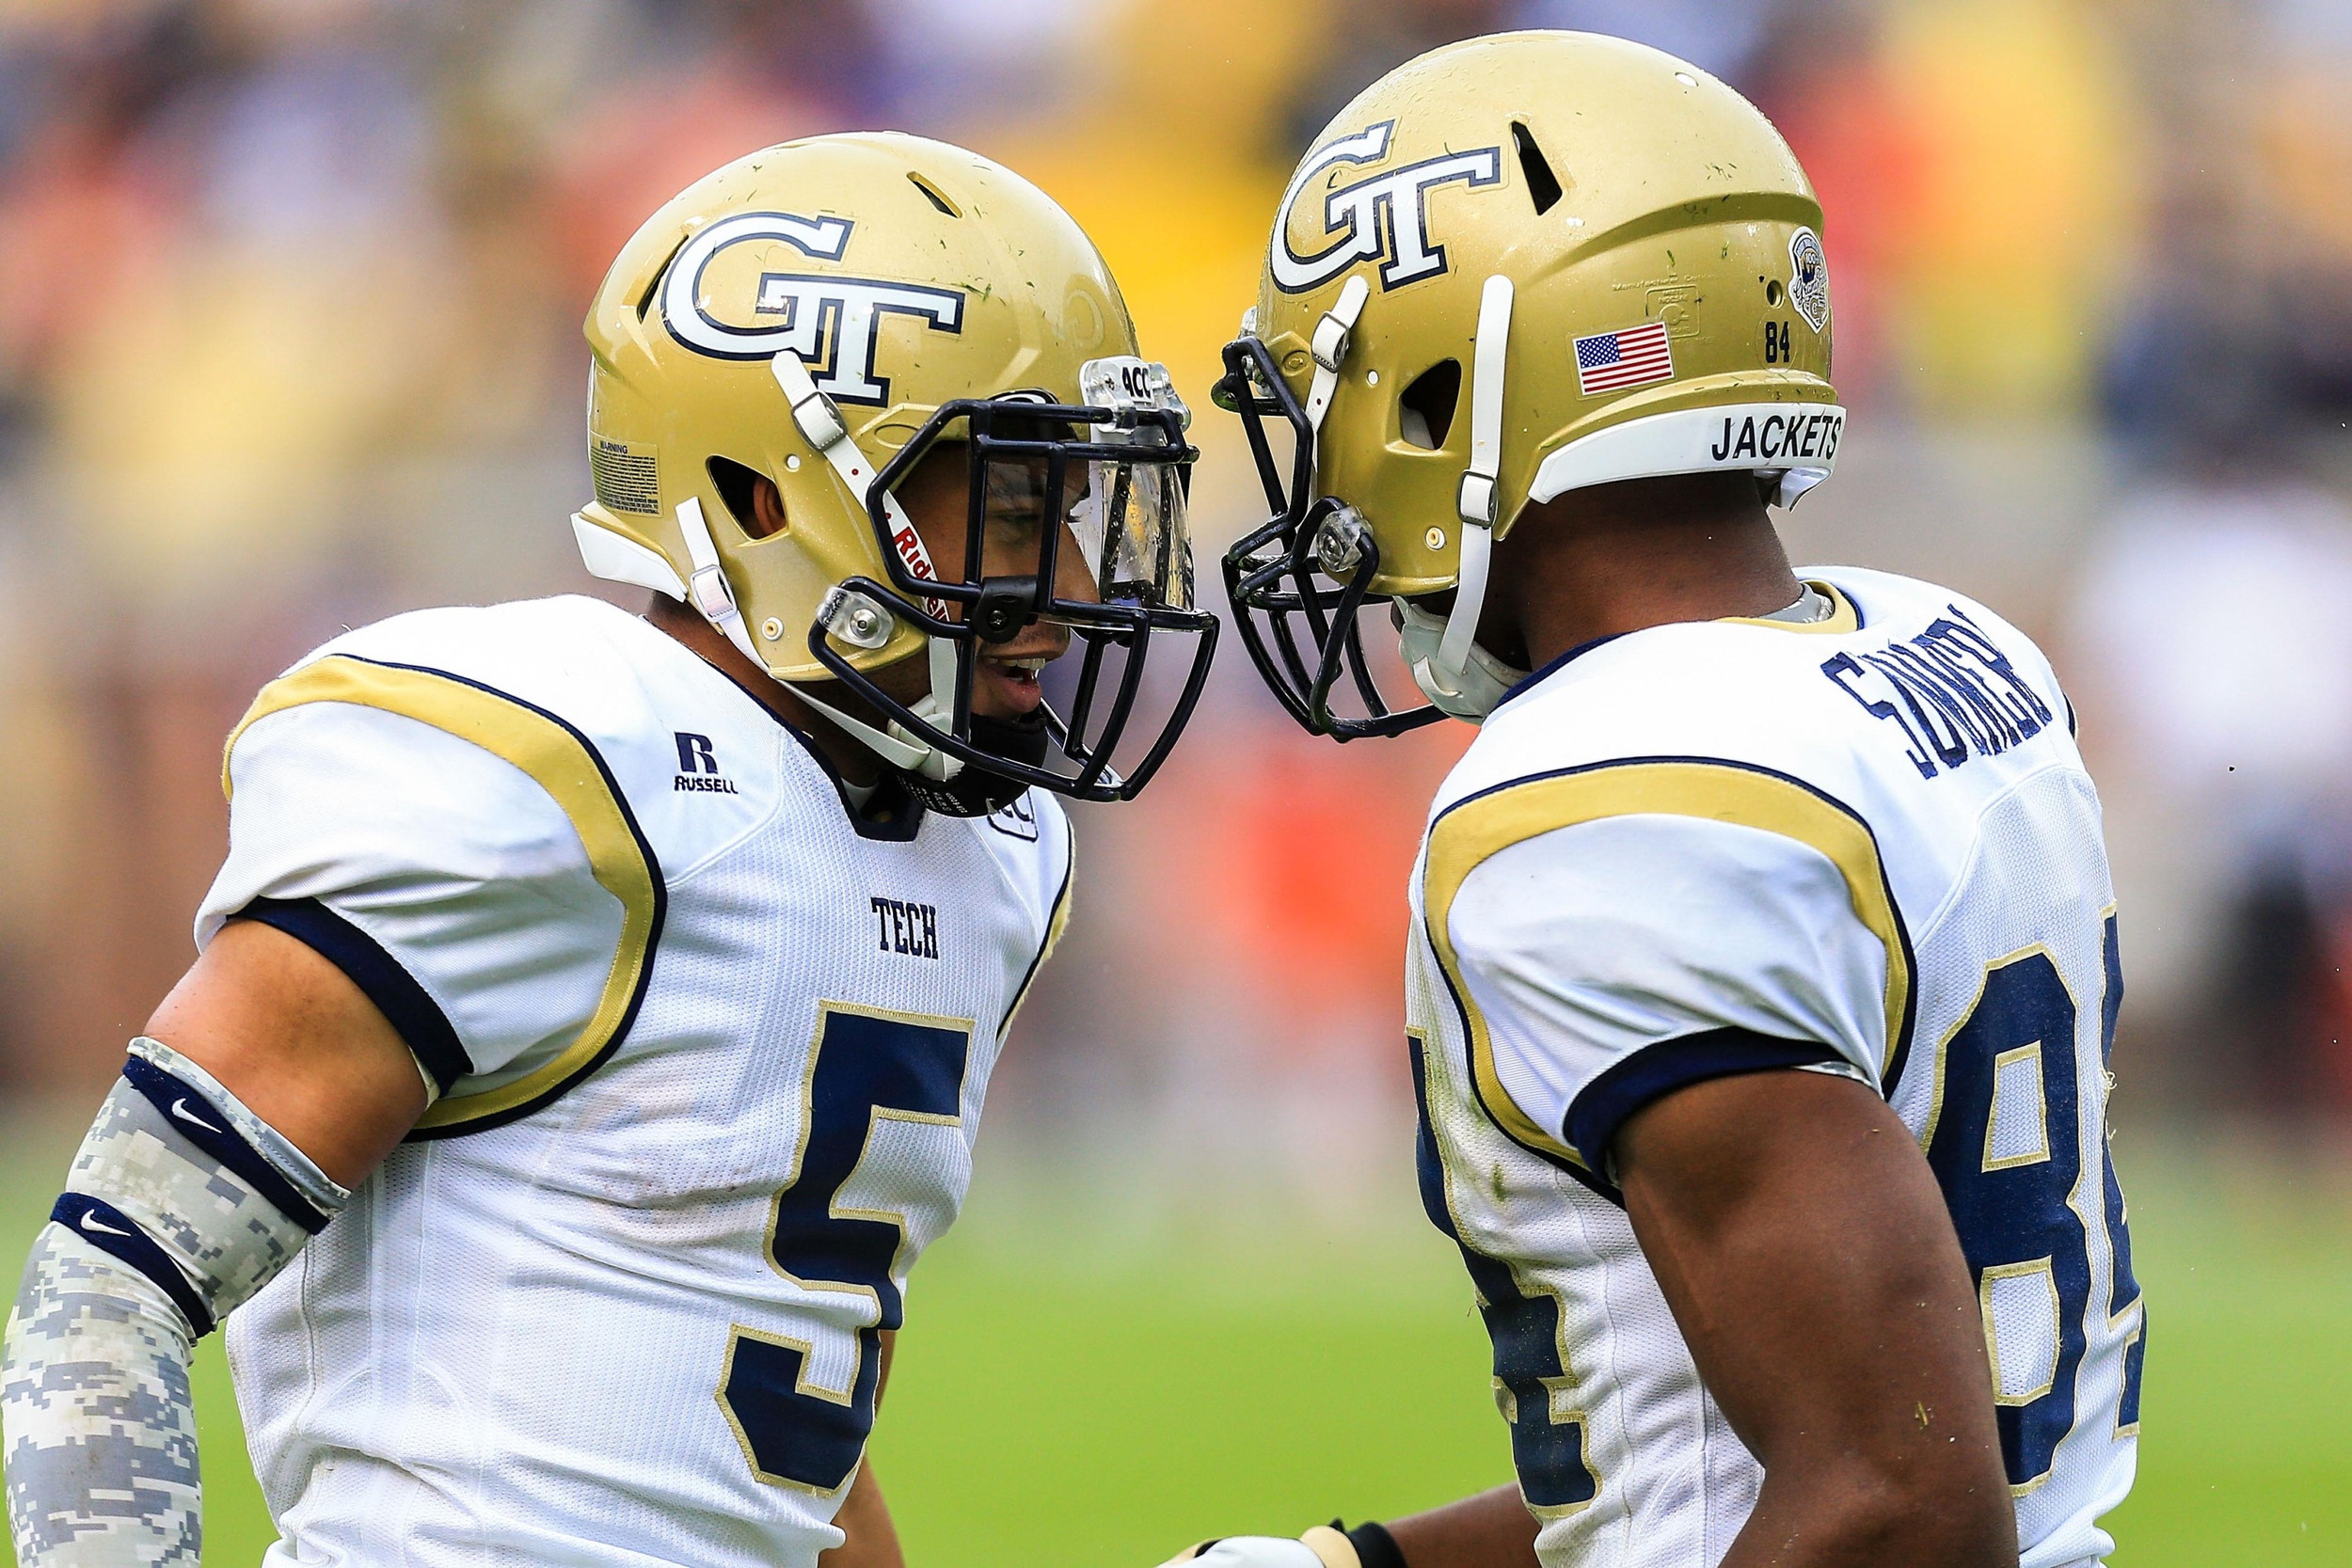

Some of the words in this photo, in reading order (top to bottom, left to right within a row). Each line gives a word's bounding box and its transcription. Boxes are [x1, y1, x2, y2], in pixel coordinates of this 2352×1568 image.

[1270, 119, 1502, 294] GT
[660, 211, 966, 408] GT
[1765, 321, 1790, 363] 84
[1711, 415, 1842, 462] JACKETS
[1820, 603, 2053, 780] SUMMER
[674, 775, 739, 795] RUSSELL
[870, 896, 939, 960] TECH
[714, 999, 976, 1497] 5
